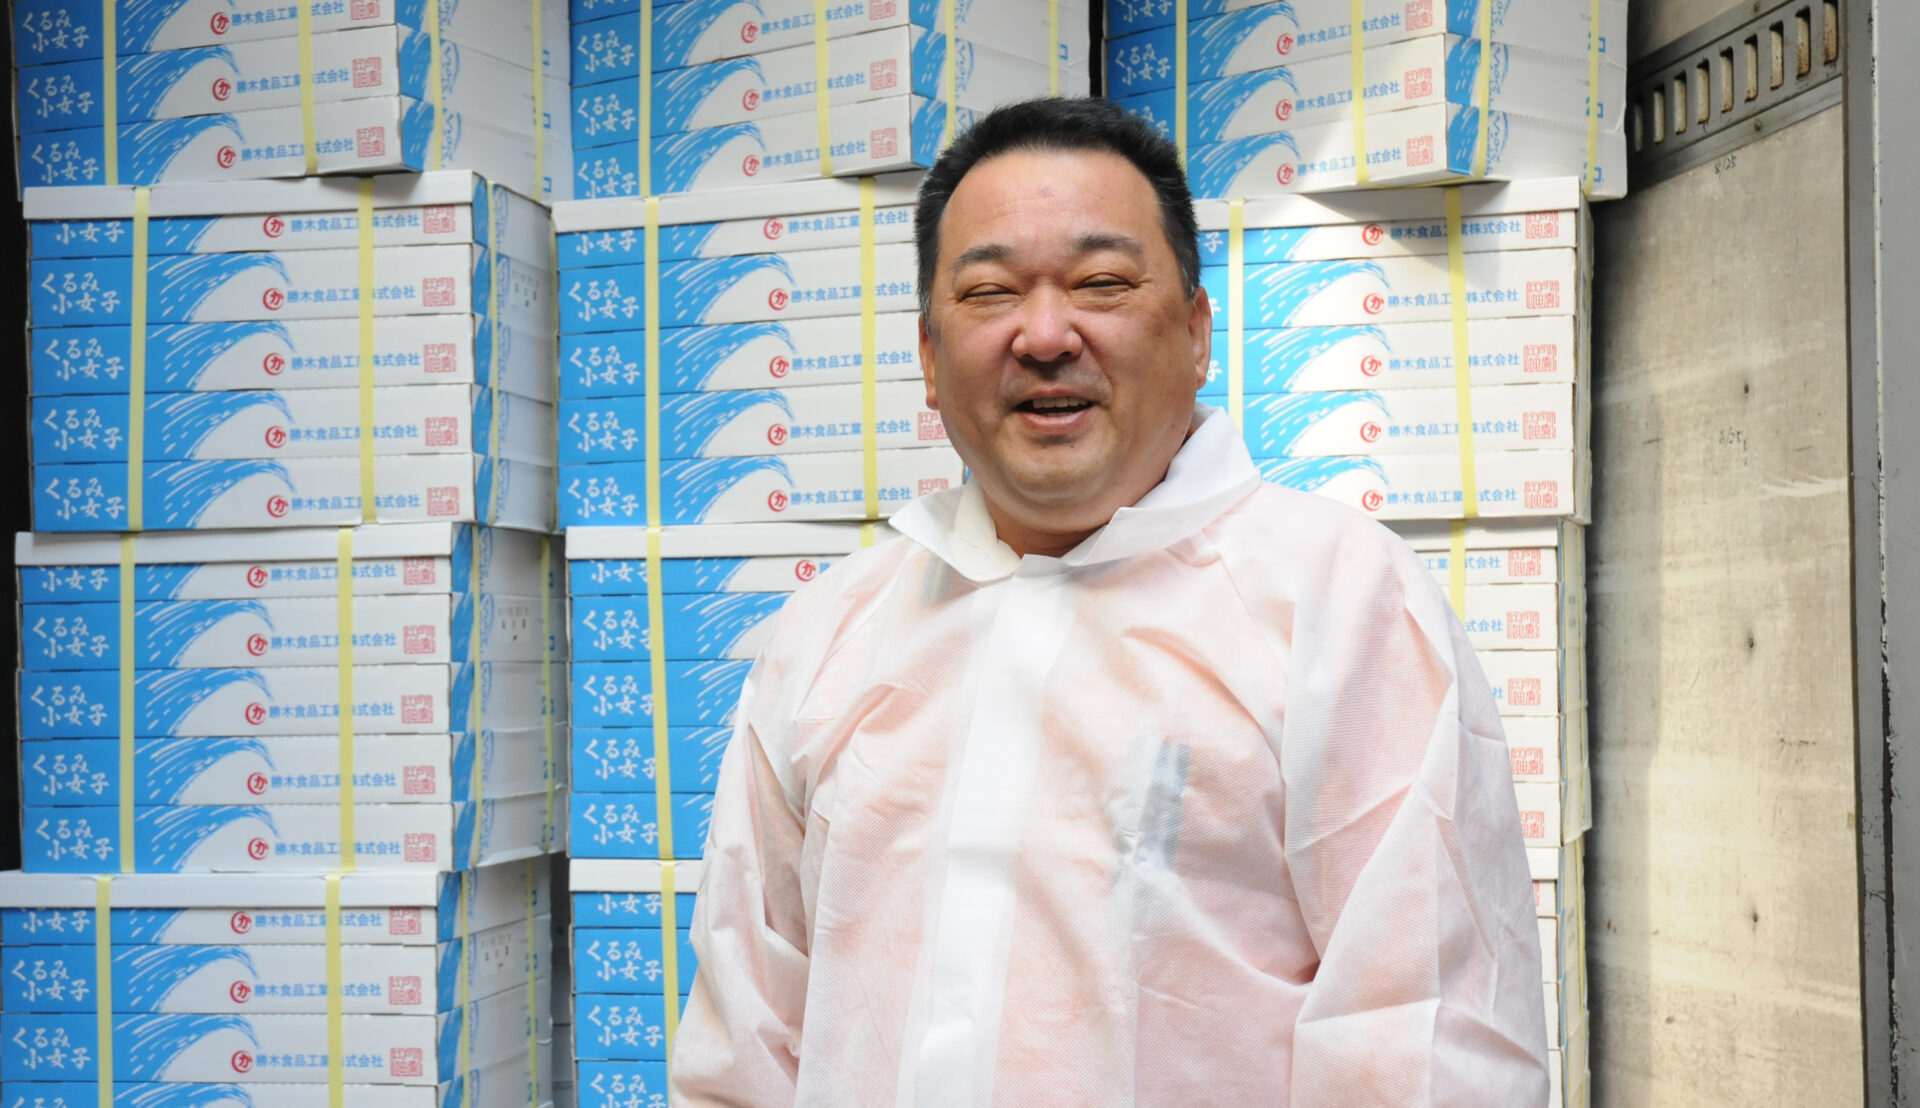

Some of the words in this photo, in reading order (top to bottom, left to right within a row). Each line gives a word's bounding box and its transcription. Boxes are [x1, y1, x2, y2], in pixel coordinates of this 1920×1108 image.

[23, 10, 71, 33] くるみ
[32, 26, 89, 52] 小女子
[578, 30, 619, 55] くるみ
[585, 45, 635, 73] 小女子
[1115, 44, 1156, 67] くるみ
[1122, 57, 1171, 86] 小女子
[28, 75, 76, 98] くるみ
[37, 92, 94, 118] 小女子
[578, 94, 620, 118] くるみ
[586, 109, 636, 137] 小女子
[32, 141, 81, 164] くるみ
[41, 158, 99, 184] 小女子
[578, 157, 621, 181] くるみ
[586, 173, 637, 199] 小女子
[56, 221, 125, 244] 小女子
[576, 231, 638, 255] 小女子
[42, 272, 99, 294] くるみ
[569, 280, 621, 302] くるみ
[53, 291, 121, 314] 小女子
[578, 297, 640, 320] 小女子
[46, 338, 103, 360] くるみ
[570, 346, 622, 367] くるみ
[56, 358, 125, 381] 小女子
[580, 364, 641, 387] 小女子
[44, 408, 102, 430] くるみ
[568, 411, 620, 432] くるみ
[55, 428, 123, 450] 小女子
[577, 429, 639, 453] 小女子
[46, 478, 104, 499] くるみ
[568, 477, 620, 498] くるみ
[57, 497, 126, 520] 小女子
[577, 495, 639, 518] 小女子
[42, 569, 109, 592] 小女子
[33, 616, 89, 638] くるみ
[582, 610, 639, 631] くるみ
[43, 635, 110, 658] 小女子
[31, 685, 87, 707] くるみ
[583, 675, 639, 696] くるみ
[42, 704, 108, 727] 小女子
[584, 739, 641, 760] くるみ
[33, 754, 89, 775] くるみ
[43, 773, 110, 796] 小女子
[583, 804, 640, 824] くるみ
[36, 819, 92, 841] くるみ
[593, 824, 659, 844] 小女子
[47, 838, 114, 860] 小女子
[597, 894, 662, 915] 小女子
[23, 910, 91, 933] 小女子
[586, 940, 643, 961] くるみ
[12, 959, 69, 981] くるみ
[597, 960, 662, 981] 小女子
[22, 979, 89, 1002] 小女子
[588, 1005, 644, 1026] くるみ
[13, 1027, 70, 1048] くるみ
[598, 1026, 664, 1047] 小女子
[23, 1047, 91, 1070] 小女子
[590, 1073, 647, 1094] くるみ
